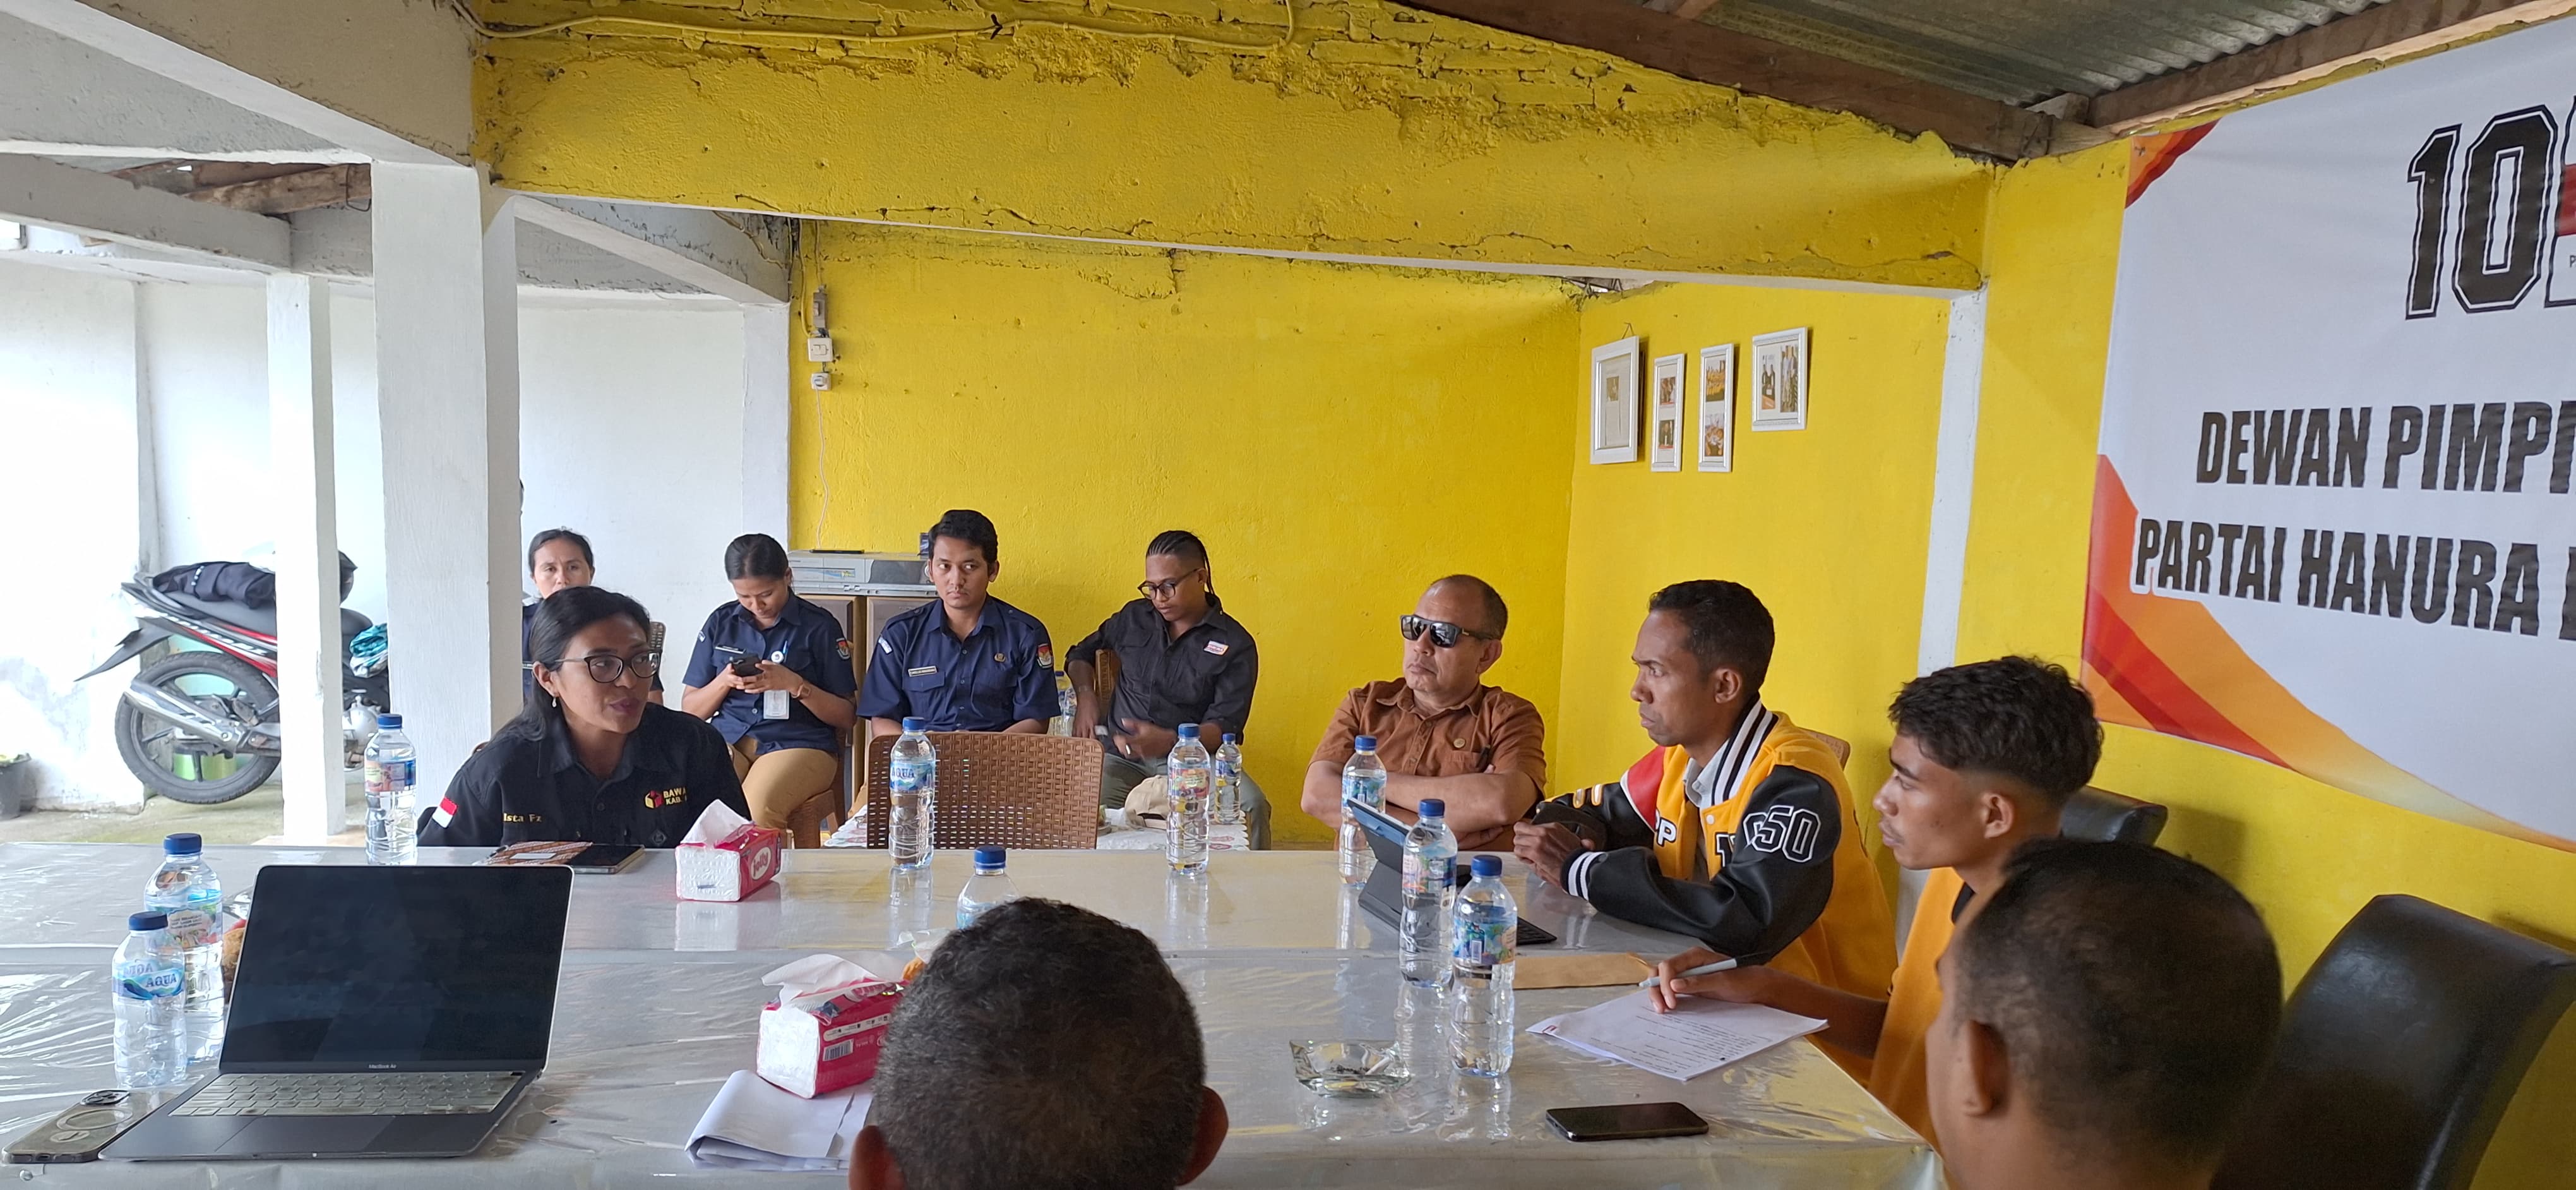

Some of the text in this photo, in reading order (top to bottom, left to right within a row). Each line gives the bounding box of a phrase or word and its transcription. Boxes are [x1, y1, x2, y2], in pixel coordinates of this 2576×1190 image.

[2406, 104, 2558, 320] 10
[2197, 406, 2372, 488] DEWAN
[2135, 518, 2287, 603] PARTAI
[2297, 528, 2539, 637] HANURA
[891, 767, 915, 779] AQUA
[145, 973, 177, 988] AQUA
